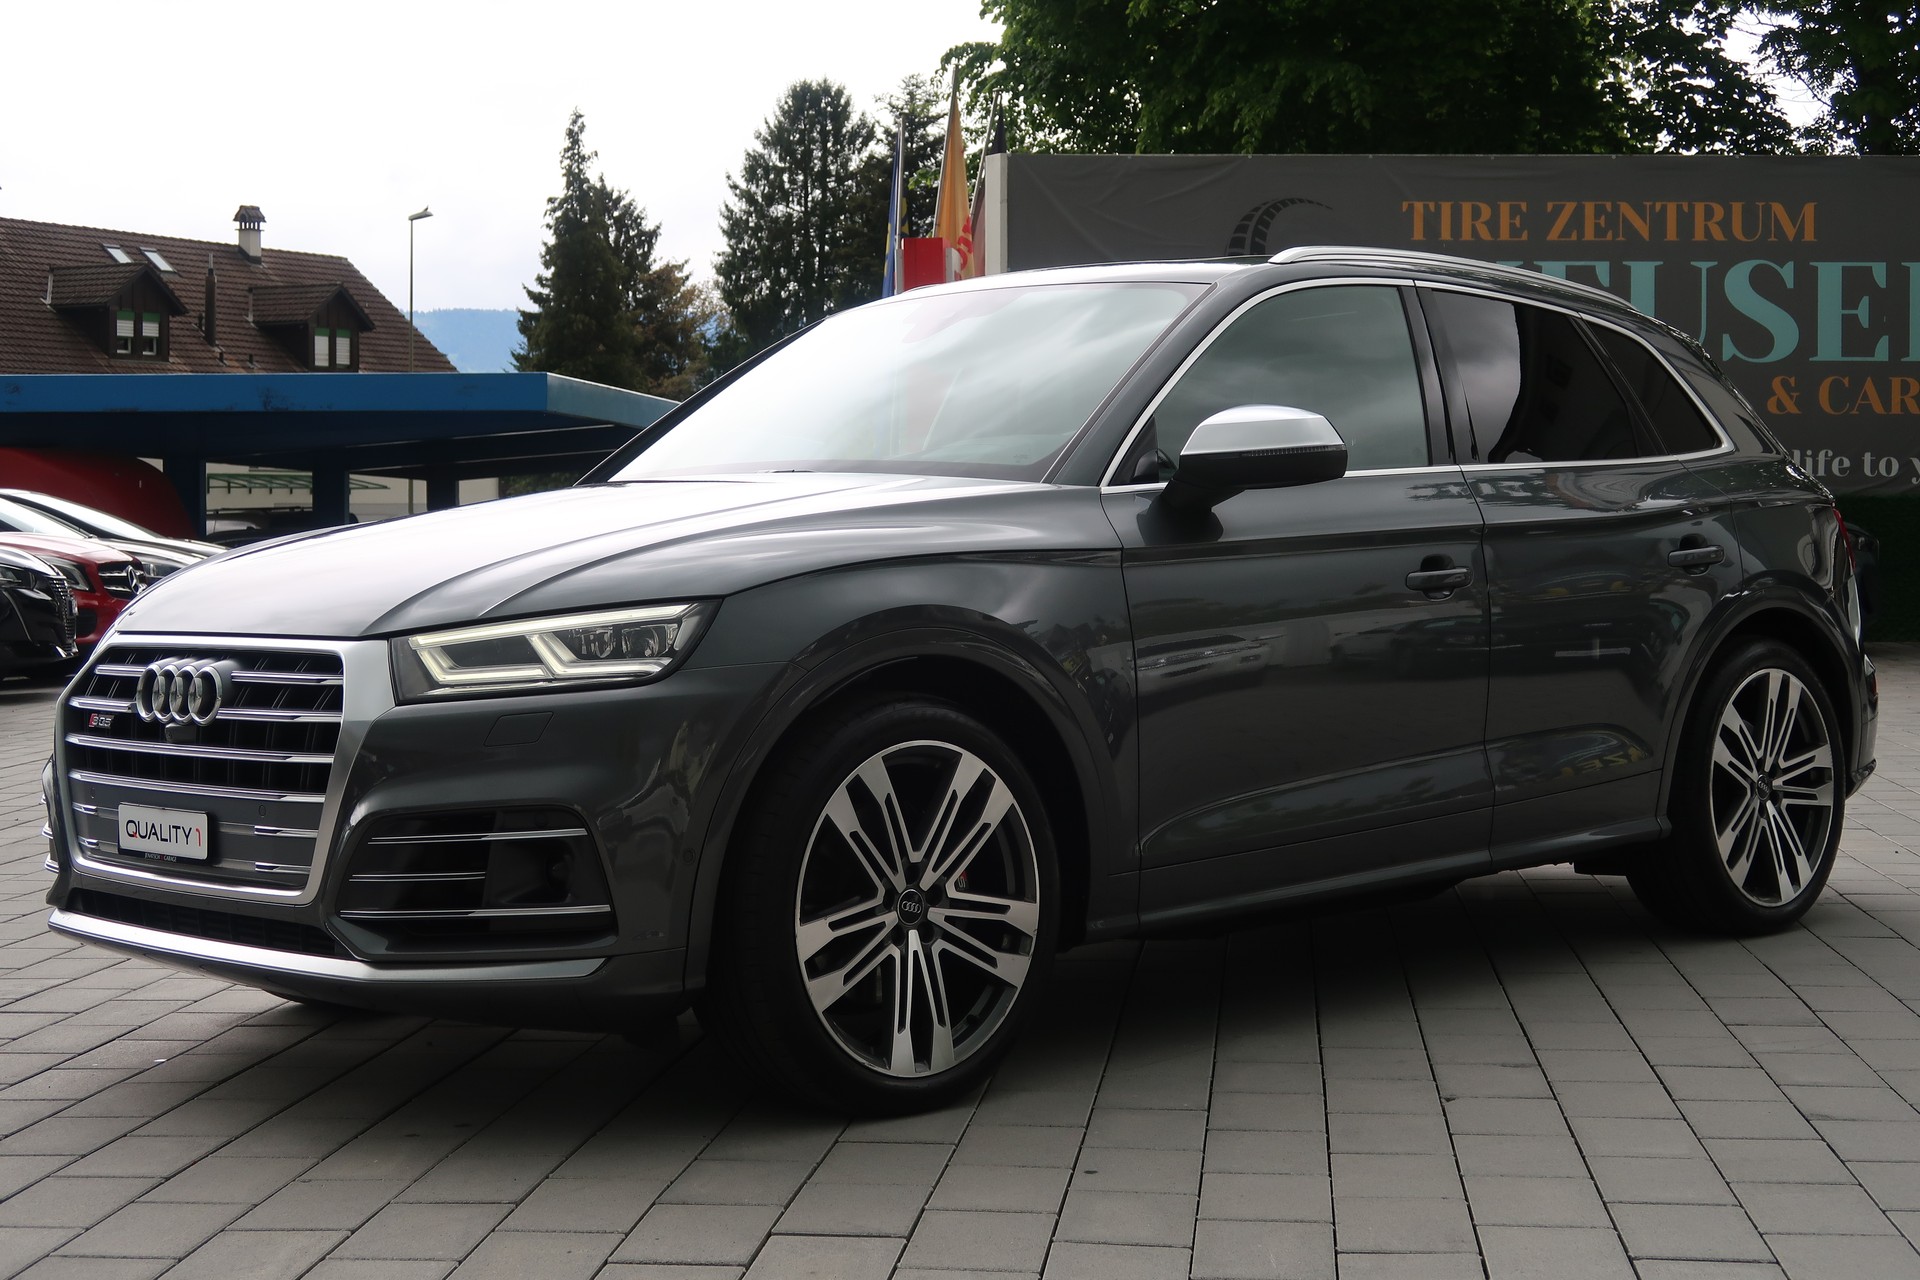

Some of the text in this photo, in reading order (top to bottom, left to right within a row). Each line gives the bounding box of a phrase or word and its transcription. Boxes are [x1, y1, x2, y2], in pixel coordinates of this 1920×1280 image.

[1402, 201, 1818, 242] TIRE ZENTRUM
[1767, 375, 1802, 415] &
[1862, 452, 1899, 477] to
